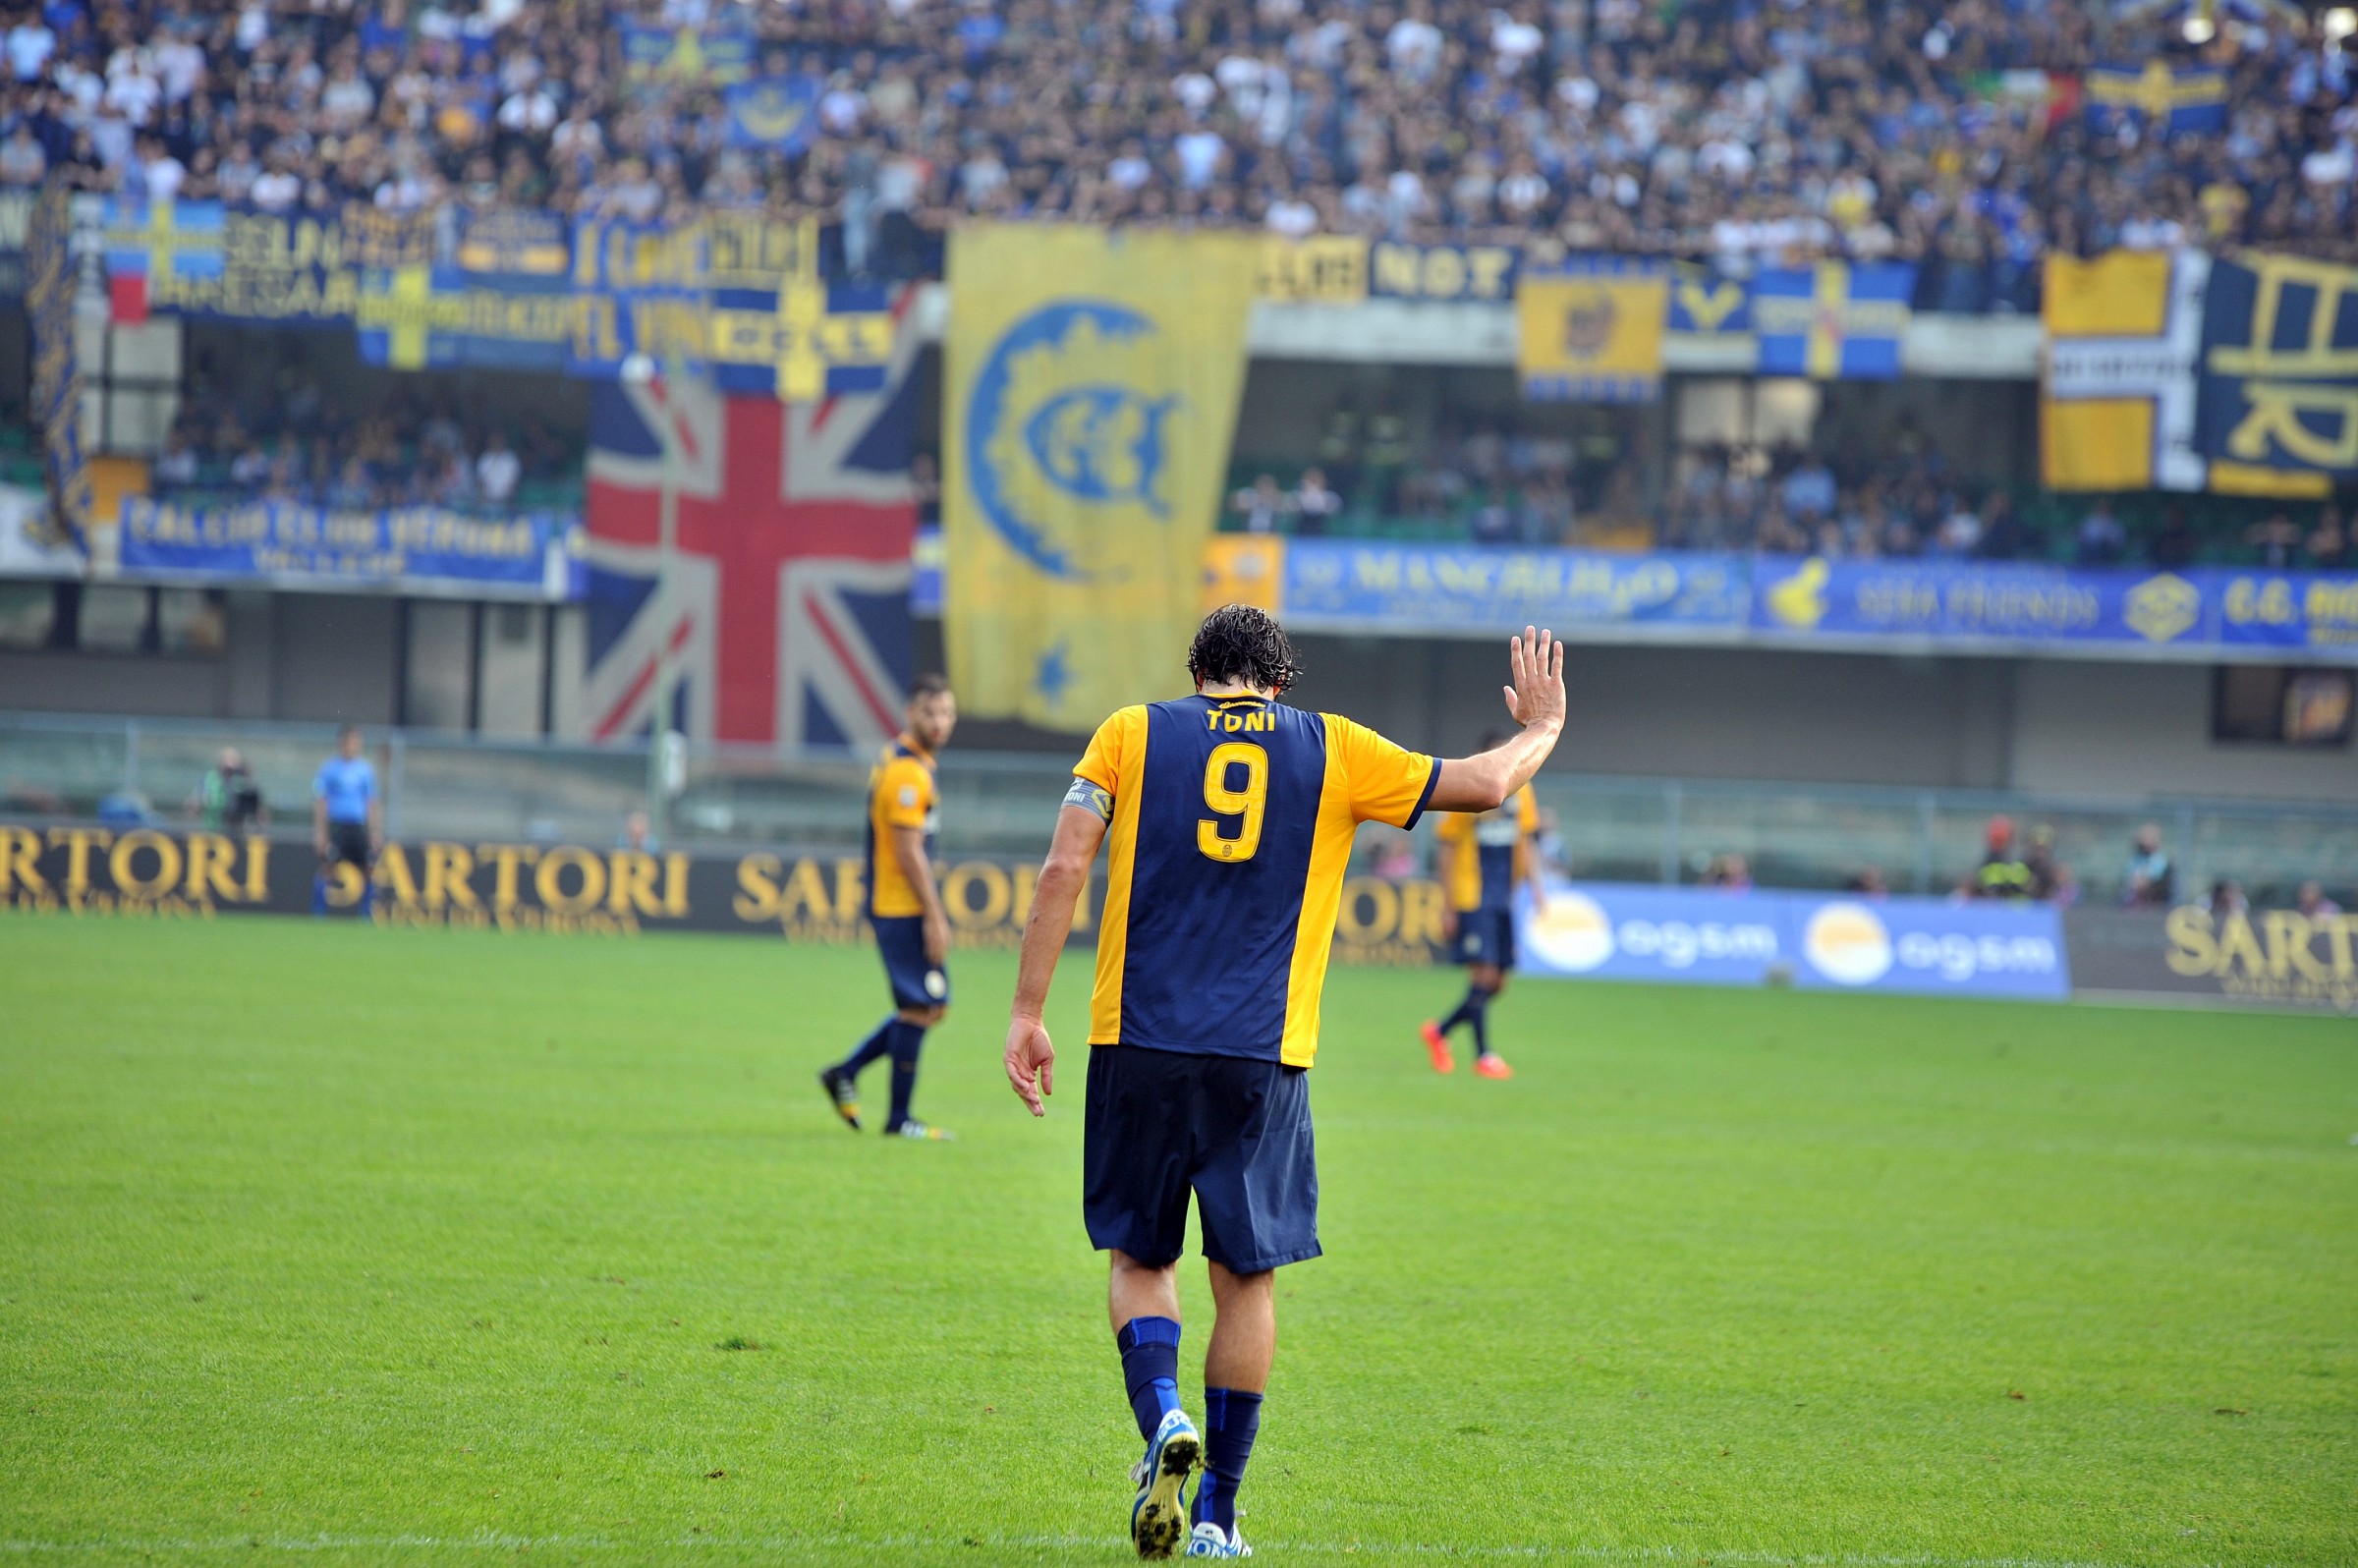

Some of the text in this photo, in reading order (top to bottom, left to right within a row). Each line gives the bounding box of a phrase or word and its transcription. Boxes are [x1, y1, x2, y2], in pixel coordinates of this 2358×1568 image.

[1207, 708, 1275, 733] TONI
[1197, 742, 1269, 863] 9
[1618, 919, 1779, 970] agsm
[1896, 929, 2058, 981] agsm
